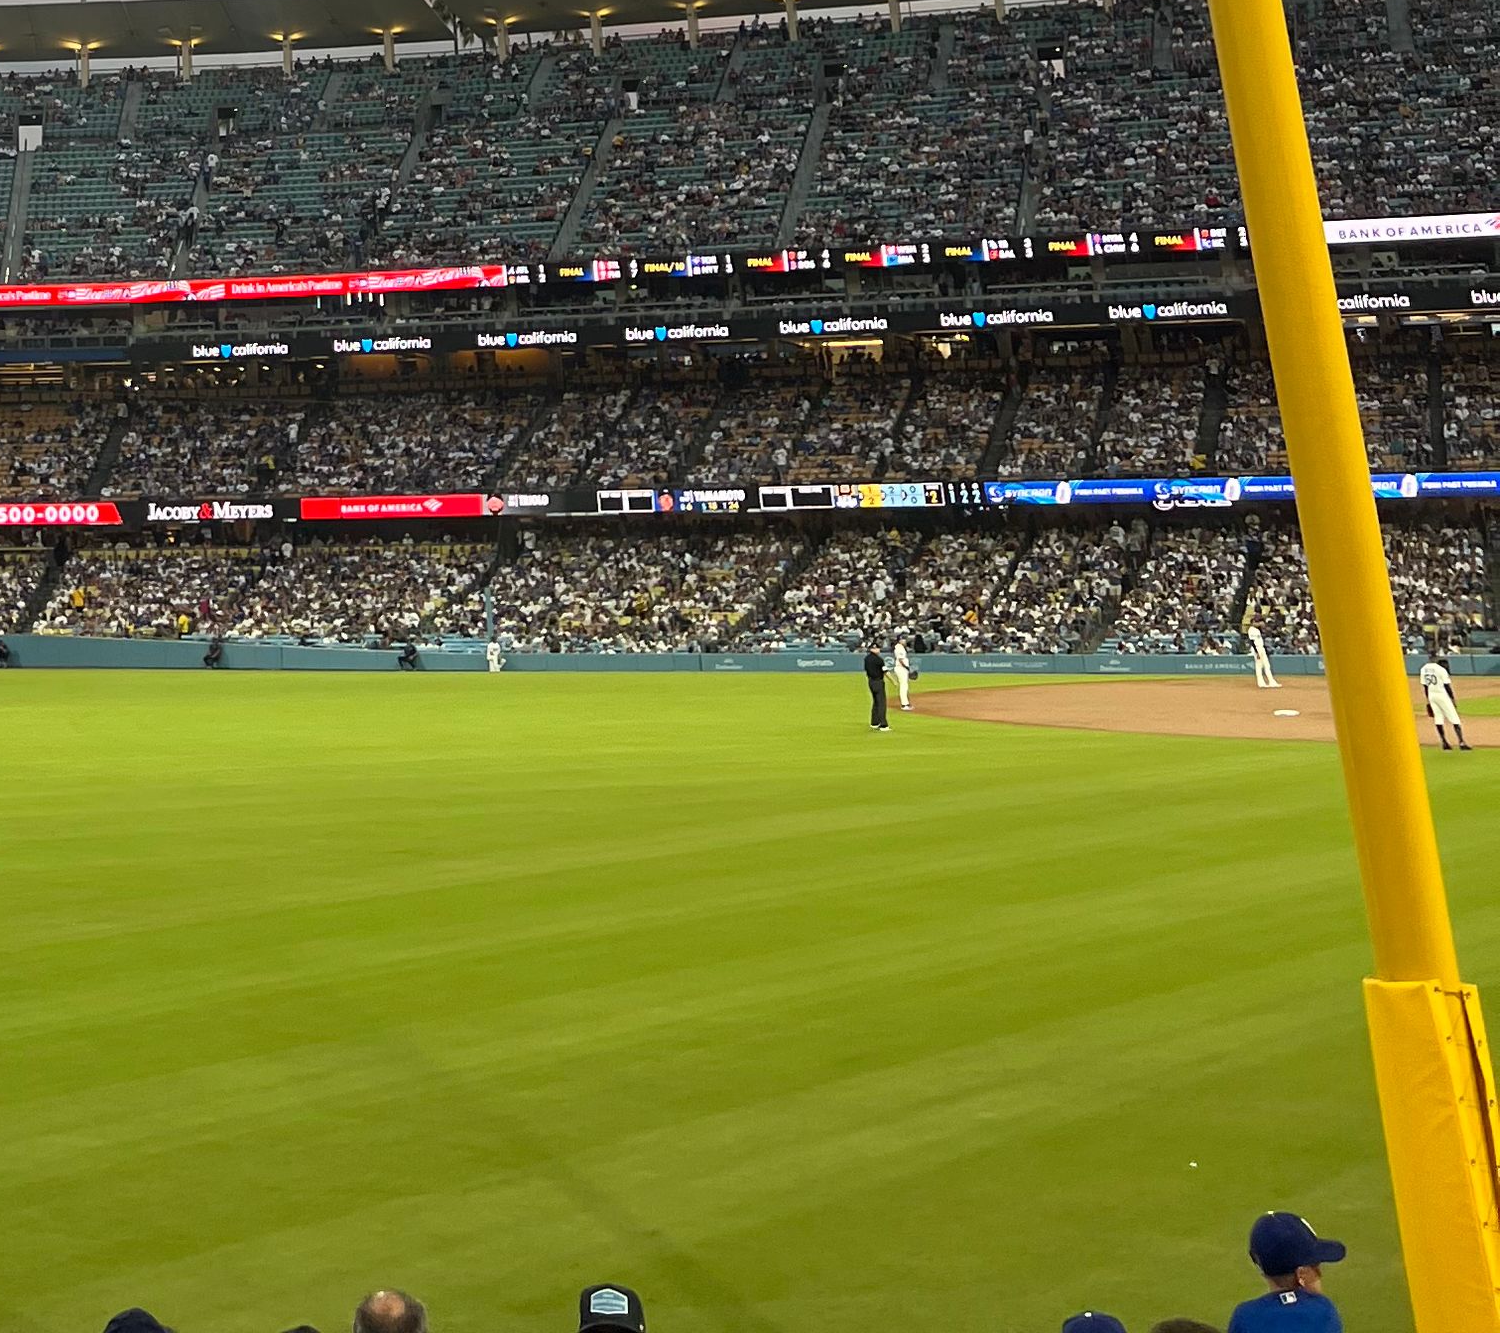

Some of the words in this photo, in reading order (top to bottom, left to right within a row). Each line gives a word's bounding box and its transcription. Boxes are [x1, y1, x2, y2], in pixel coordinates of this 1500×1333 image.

[1339, 227, 1381, 239] BANK
[1386, 226, 1404, 238] OF
[1410, 223, 1482, 236] AMERICA
[1129, 232, 1138, 243] 4
[1154, 235, 1183, 246] FINAL
[921, 243, 930, 254] 2
[1048, 240, 1076, 251] FINAL
[945, 246, 973, 257] FINAL
[747, 258, 774, 268] FINAL
[845, 252, 872, 263] FINAL
[559, 267, 584, 277] FINAL
[644, 261, 685, 273] FINAL/10
[539, 273, 547, 283] 2
[231, 282, 255, 294] Drink
[256, 282, 264, 293] in
[265, 280, 307, 293] America's
[308, 279, 342, 291] Pastime
[16, 290, 51, 301] Pastime
[1336, 294, 1410, 310] california
[1108, 305, 1142, 319] blue
[1156, 301, 1227, 317] california
[940, 312, 972, 327] blue
[986, 309, 1054, 325] california
[780, 320, 810, 334] blue
[823, 317, 888, 332] california
[625, 327, 654, 341] blue
[667, 324, 729, 339] california
[333, 339, 360, 352] blue
[373, 336, 431, 351] california
[478, 334, 506, 347] blue
[518, 330, 577, 345] california
[192, 345, 219, 358] blue
[232, 342, 288, 357] california
[909, 485, 917, 494] 0
[1004, 489, 1053, 499] SYNCRON
[1170, 485, 1221, 495] SYNCRON
[910, 496, 917, 504] 0
[930, 490, 939, 504] 2
[950, 490, 956, 504] 1
[960, 489, 969, 504] 2
[972, 489, 981, 503] 2
[341, 505, 366, 513] BANK
[367, 504, 379, 513] OF
[380, 503, 423, 513] AMERICA
[797, 658, 834, 668] Spectrum
